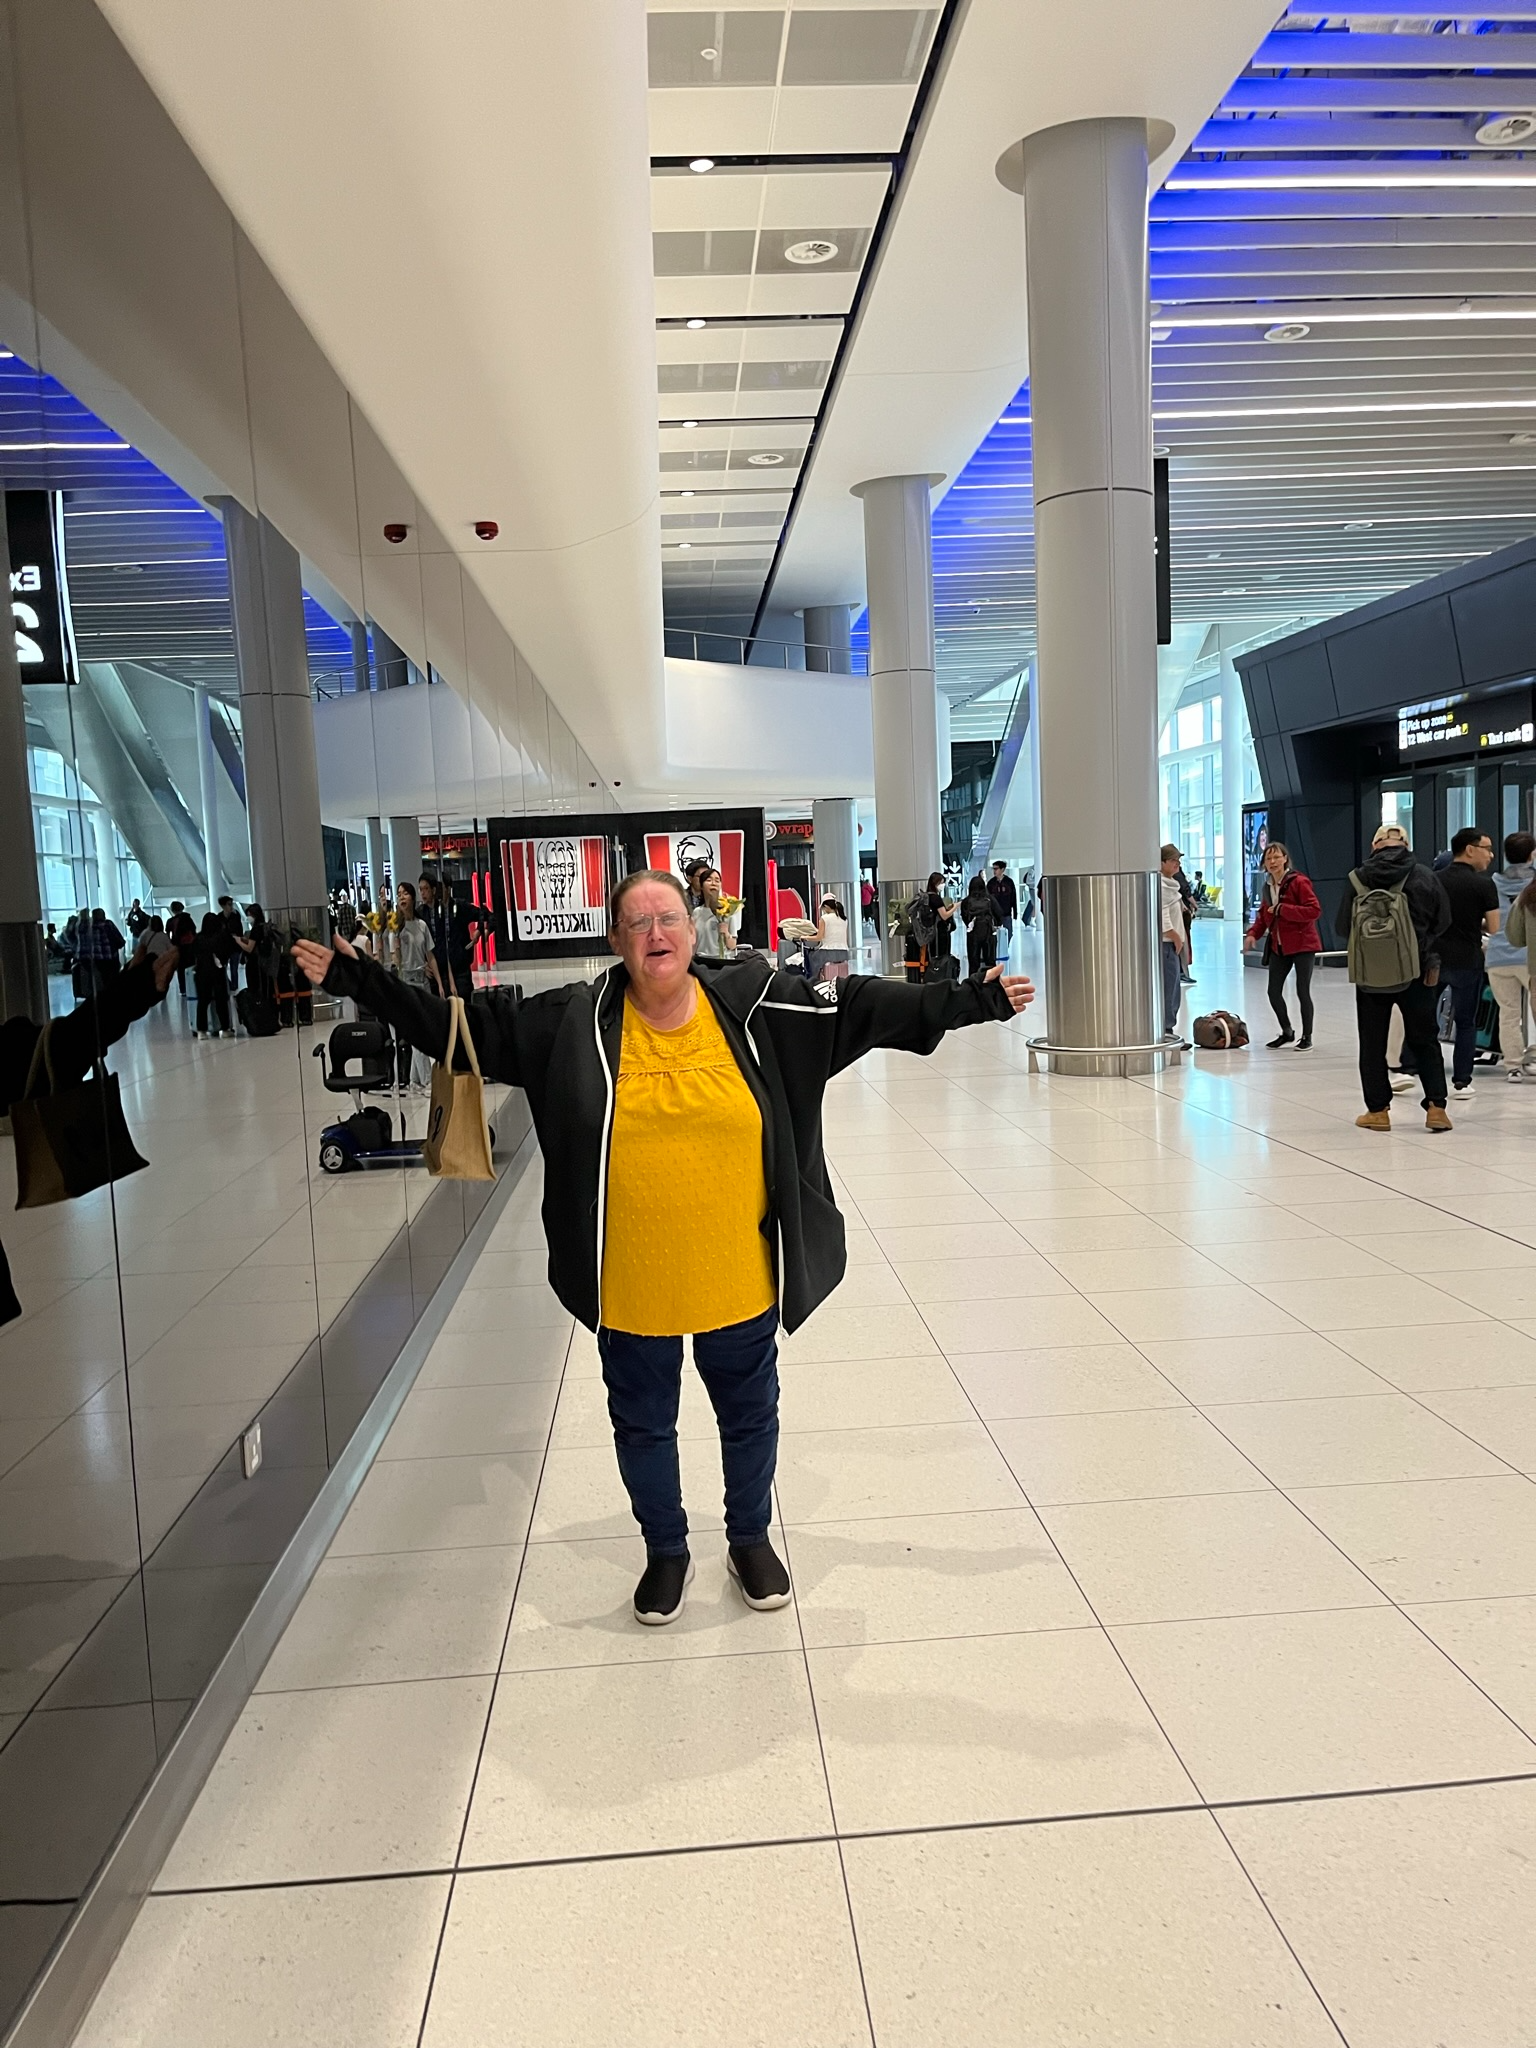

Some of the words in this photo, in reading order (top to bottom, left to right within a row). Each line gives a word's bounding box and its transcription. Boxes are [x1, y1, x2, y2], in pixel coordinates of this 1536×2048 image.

[1407, 719, 1420, 731] Pick
[1421, 719, 1430, 730] up
[1431, 715, 1447, 727] zone
[1407, 733, 1416, 746] T2
[1433, 730, 1445, 741] car
[1445, 724, 1461, 740] park
[1488, 732, 1503, 745] Taxi
[1504, 728, 1521, 743] rank
